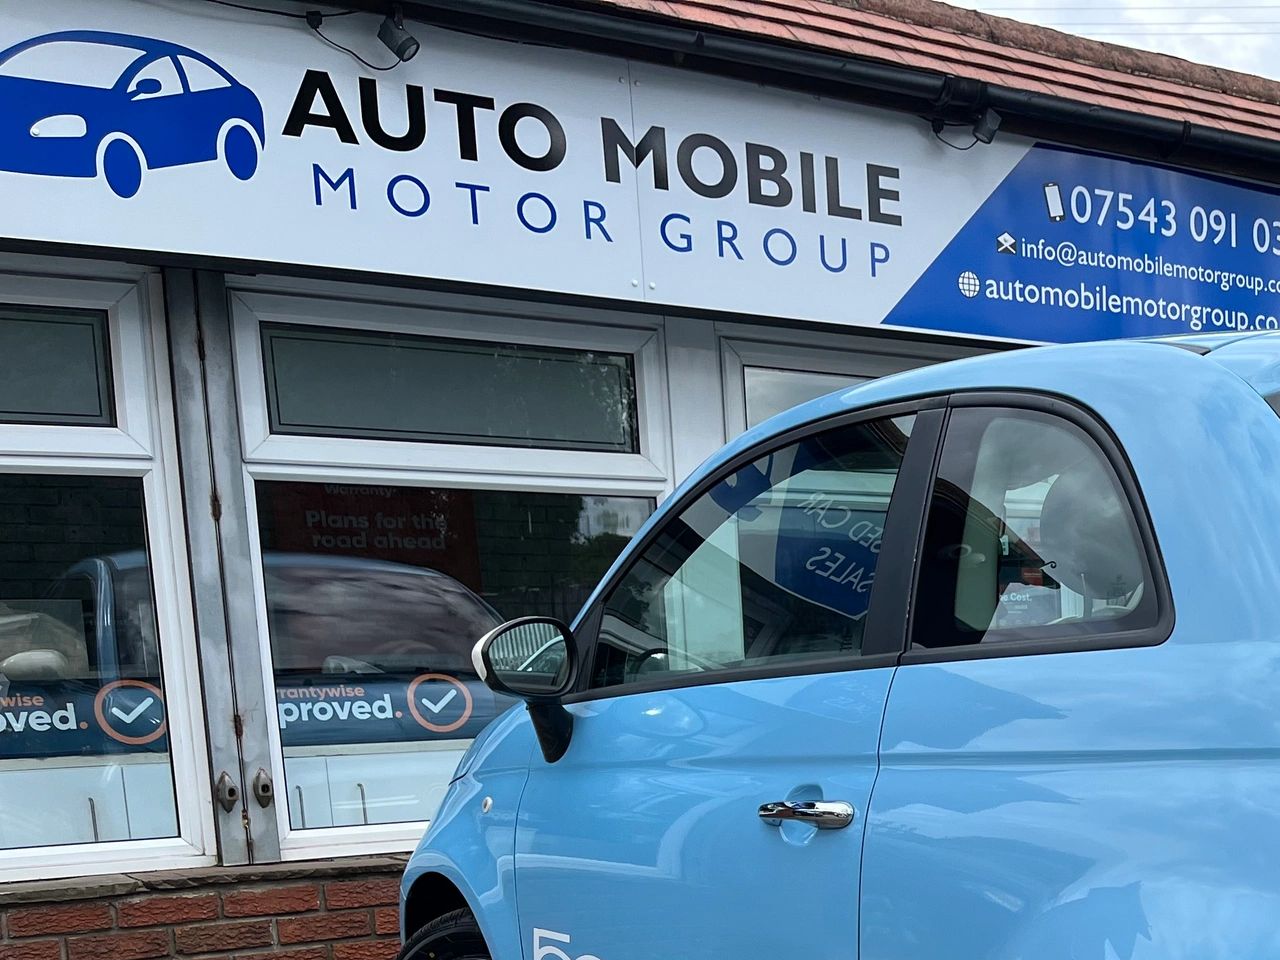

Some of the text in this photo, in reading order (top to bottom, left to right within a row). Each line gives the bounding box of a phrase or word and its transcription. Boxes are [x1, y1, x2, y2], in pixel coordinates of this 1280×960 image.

[281, 69, 902, 226] AUTO MOBILE
[313, 164, 890, 279] MOTOR GROUP
[1071, 185, 1177, 237] 07543
[1190, 206, 1237, 248] 091
[305, 510, 447, 530] Plans for the
[313, 531, 446, 550] road ahead
